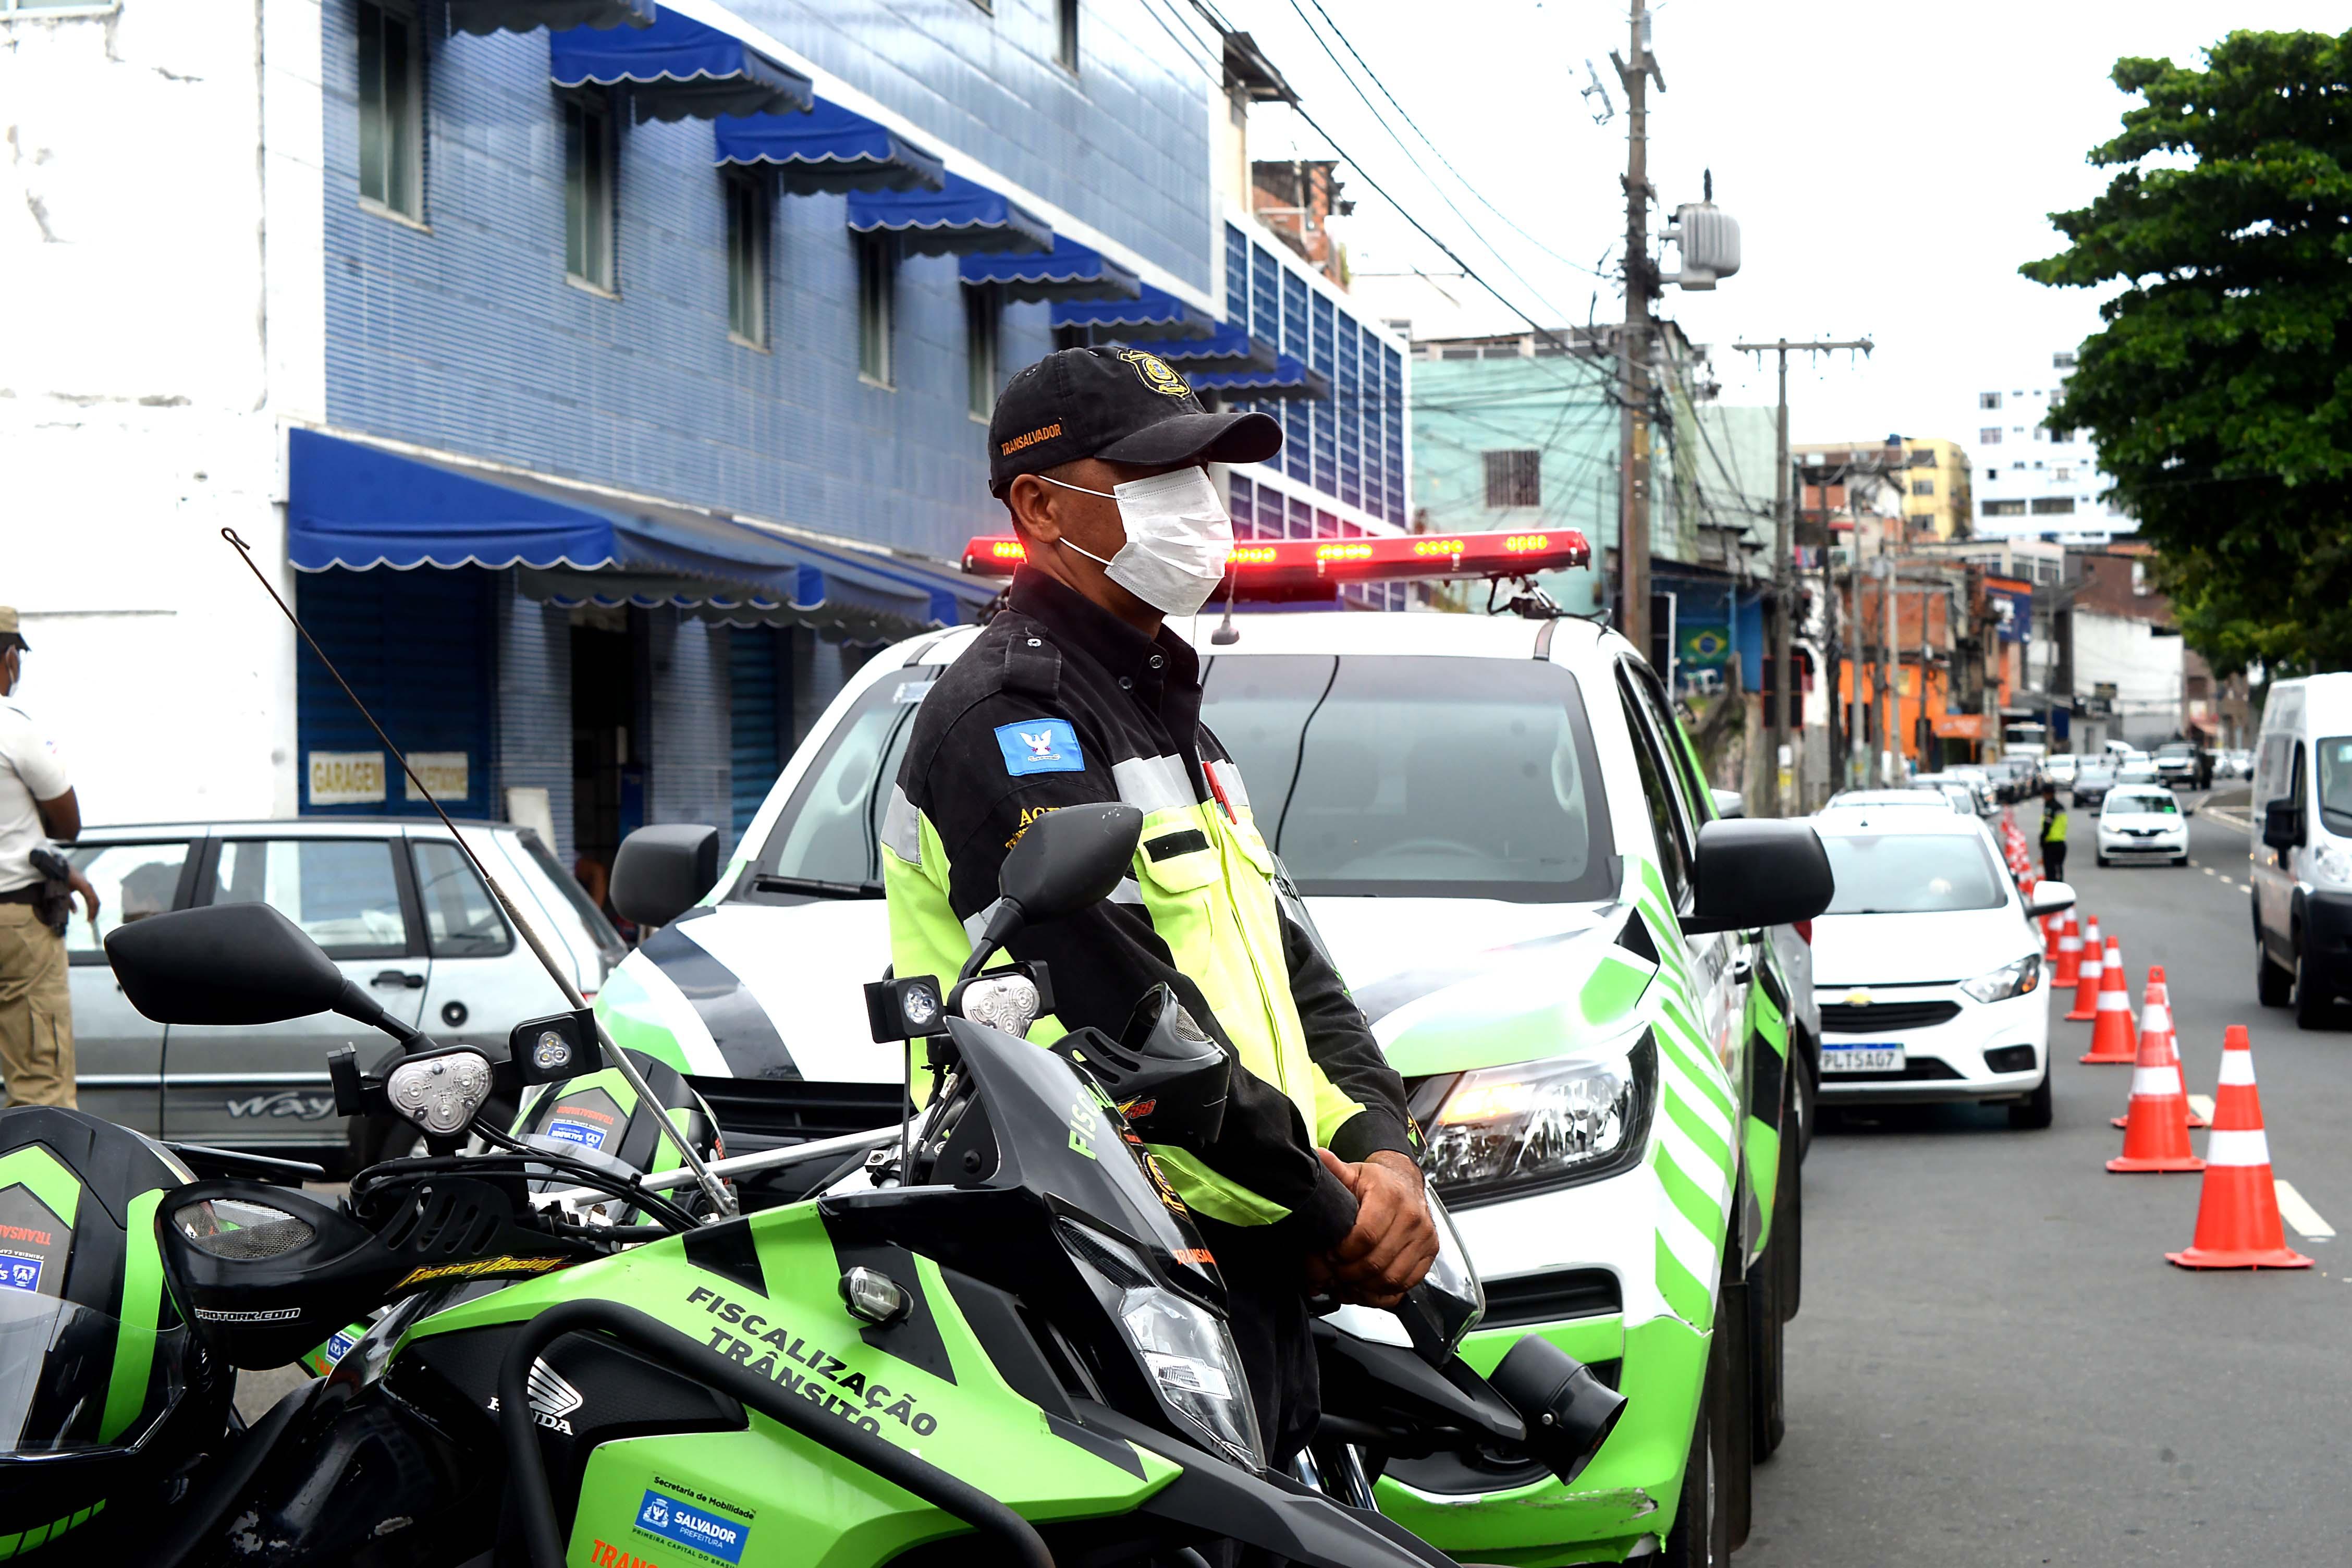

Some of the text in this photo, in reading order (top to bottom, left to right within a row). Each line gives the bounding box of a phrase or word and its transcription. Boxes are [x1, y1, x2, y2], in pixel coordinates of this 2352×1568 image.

[1001, 424, 1062, 456] TRANSALVADOR
[226, 1092, 335, 1120] Way
[0, 1224, 51, 1245] TRANSA
[686, 1285, 937, 1436] FISCALIZAÇÃO
[487, 1396, 573, 1435] HDA
[654, 1476, 754, 1520] Secretaria de Mobilidade
[632, 1528, 665, 1544] PRIMEIRA
[667, 1541, 695, 1557] CAPITAL
[674, 1511, 737, 1544] SALVADOR
[680, 1527, 723, 1549] PREFEITURA
[590, 1539, 658, 1568] TRA
